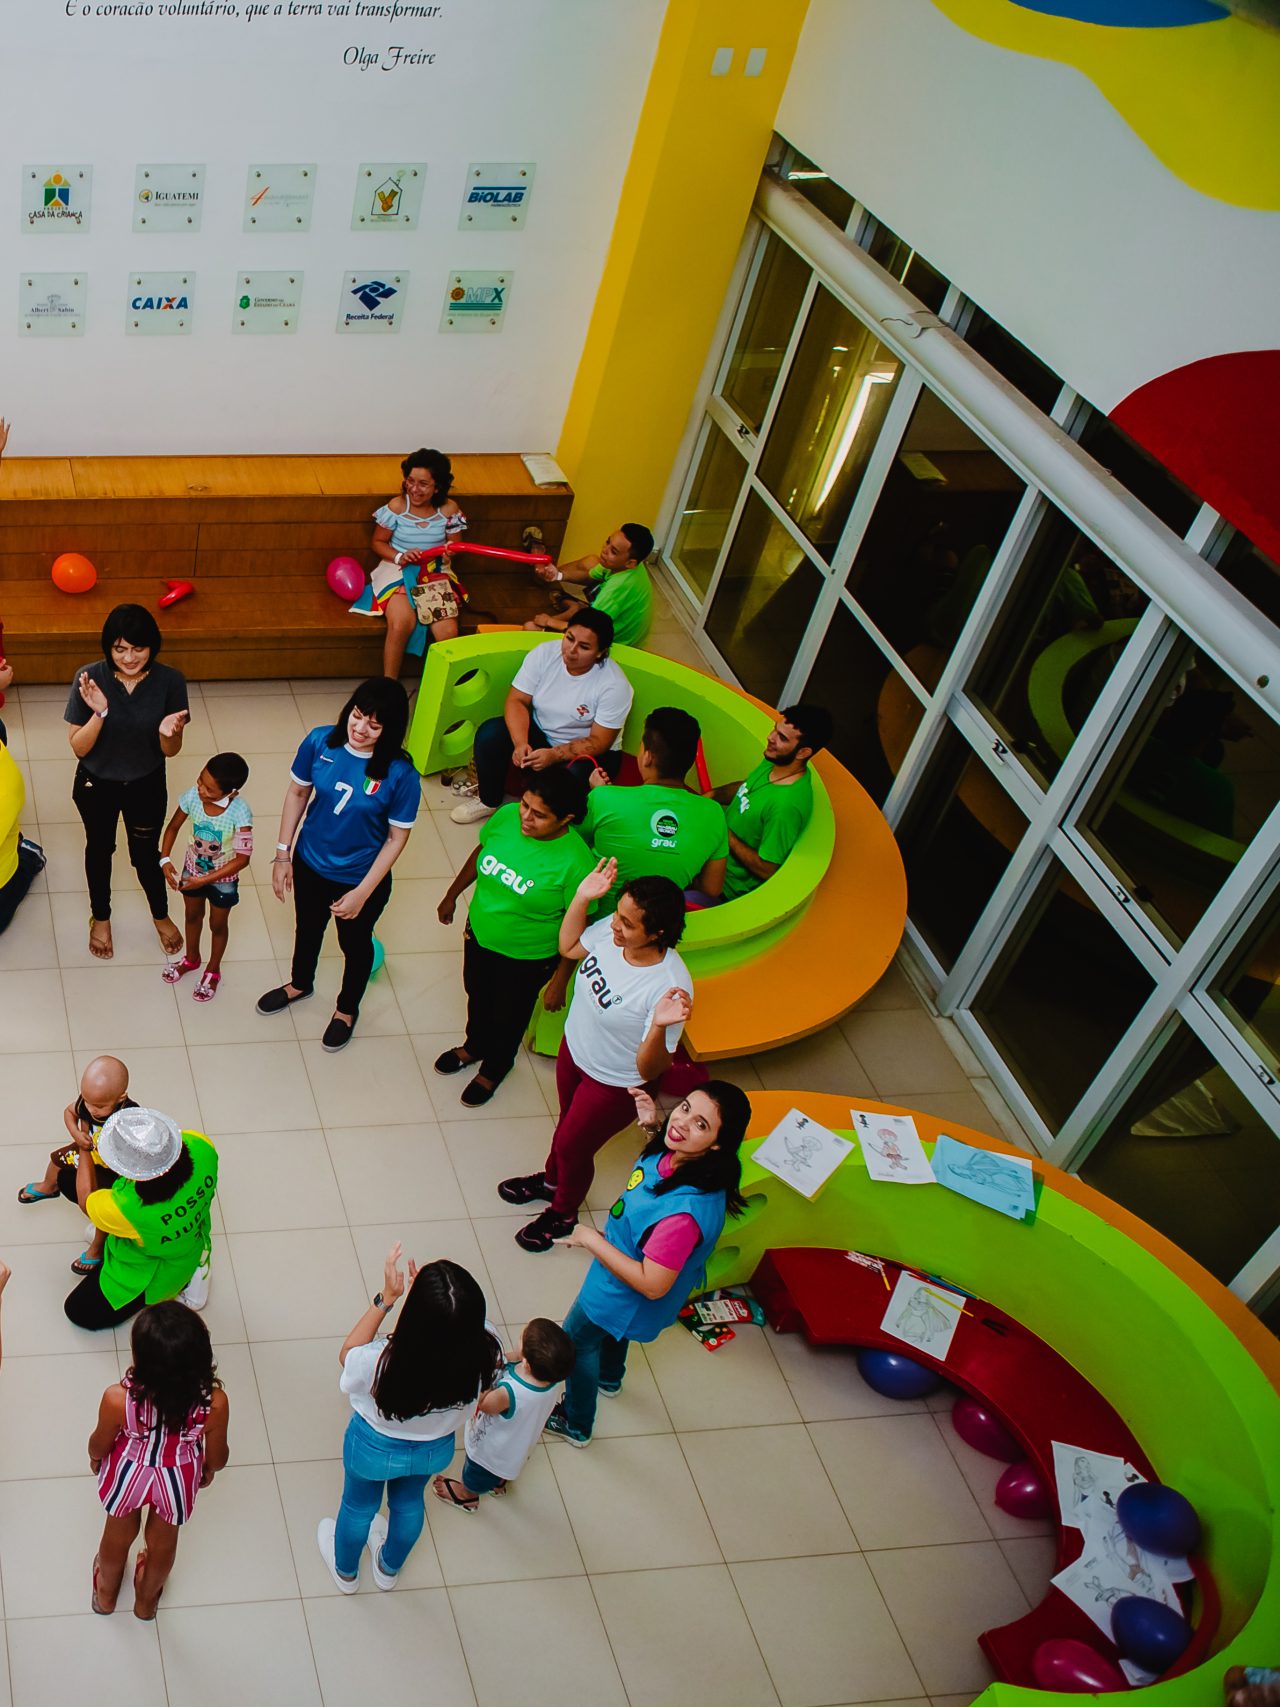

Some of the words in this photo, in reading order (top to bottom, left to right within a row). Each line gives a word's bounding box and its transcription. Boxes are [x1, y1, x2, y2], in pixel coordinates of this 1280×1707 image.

[82, 5, 91, 16] o
[158, 0, 240, 18] voluntário,
[245, 4, 270, 22] que
[273, 4, 282, 16] a
[287, 1, 322, 16] terra
[327, 0, 352, 16] vai
[355, 0, 443, 23] transformar.
[343, 46, 380, 72] Olga
[381, 46, 437, 71] Freire
[155, 191, 199, 201] IGUATEMI
[28, 210, 46, 219] CASA
[131, 296, 189, 311] CAIXA
[465, 286, 505, 303] MPX
[345, 313, 369, 321] Receita
[333, 781, 354, 816] 7
[650, 838, 676, 848] grau
[479, 854, 528, 895] grau
[579, 955, 612, 1010] grau
[160, 1175, 214, 1226] POSSO
